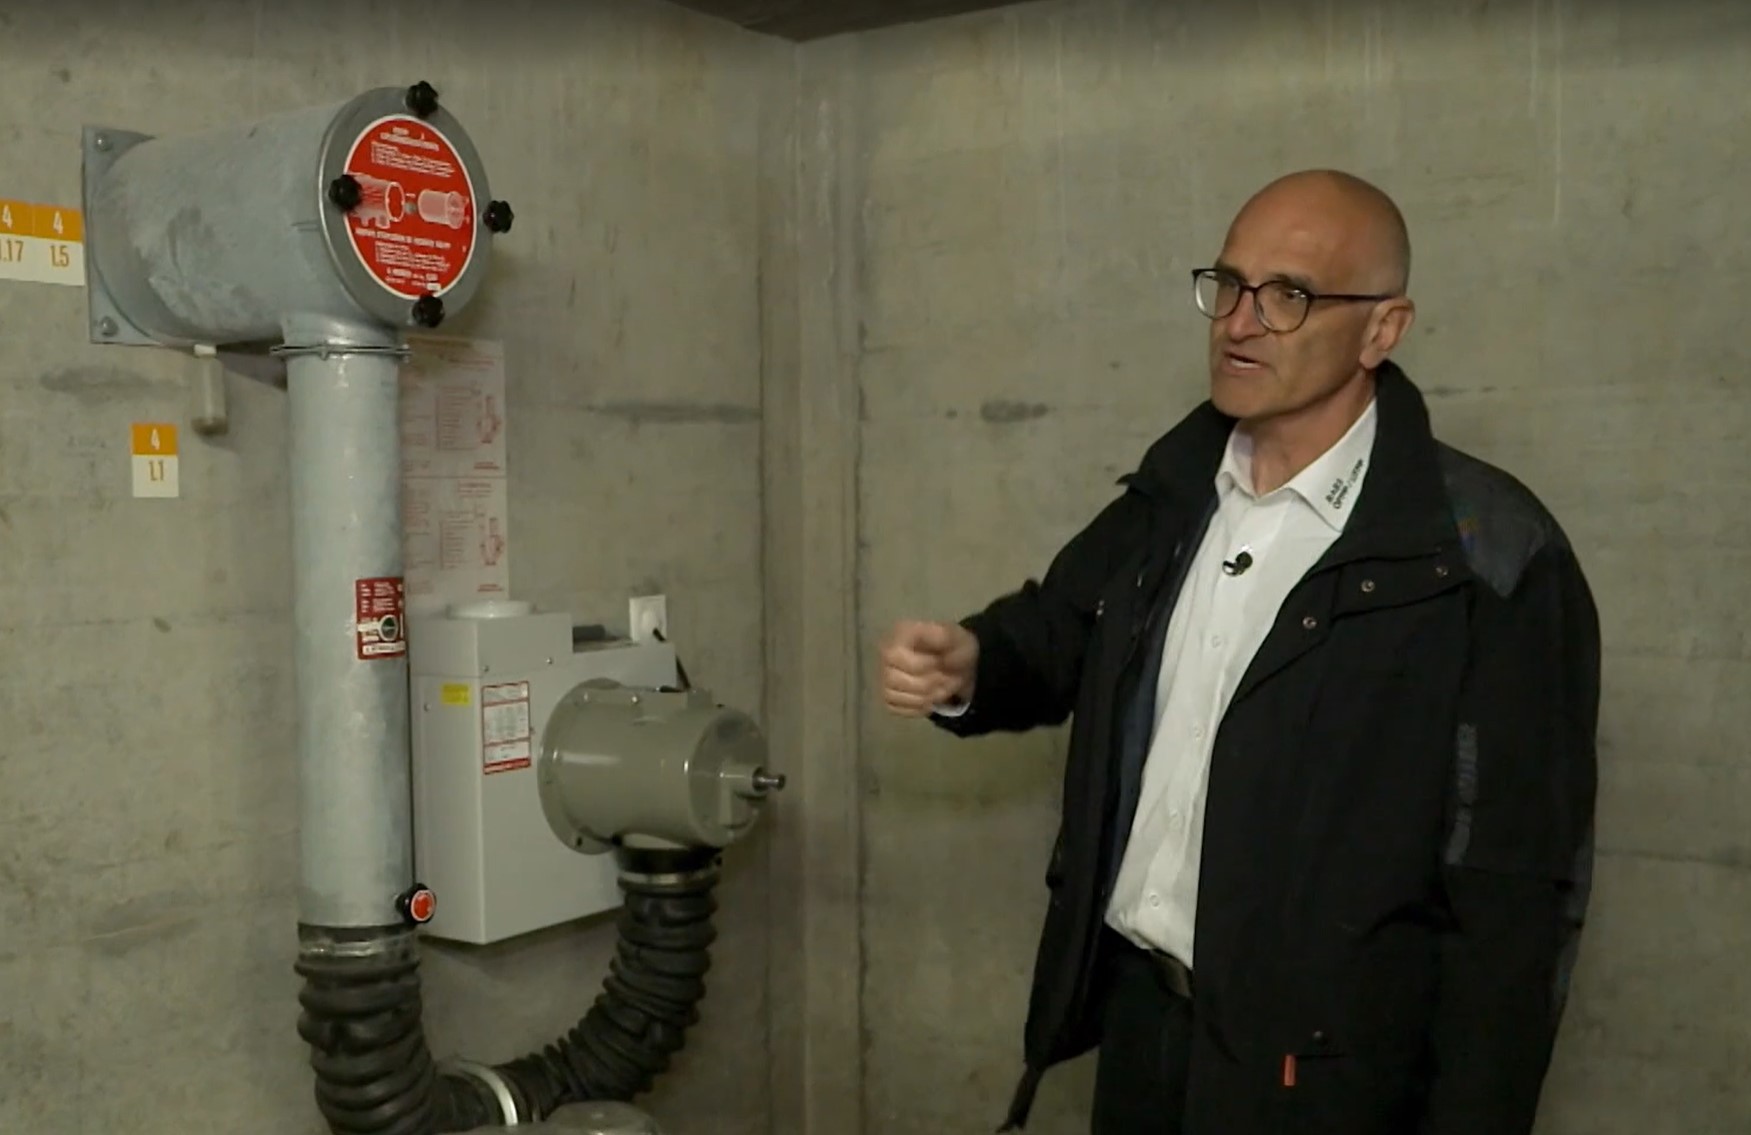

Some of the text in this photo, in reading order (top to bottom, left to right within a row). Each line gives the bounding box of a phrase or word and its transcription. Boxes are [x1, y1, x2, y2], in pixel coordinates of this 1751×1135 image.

[3, 204, 13, 230] 4
[53, 210, 64, 235] 4
[0, 239, 24, 262] .17
[50, 245, 70, 268] 1.5
[151, 427, 161, 451] 4
